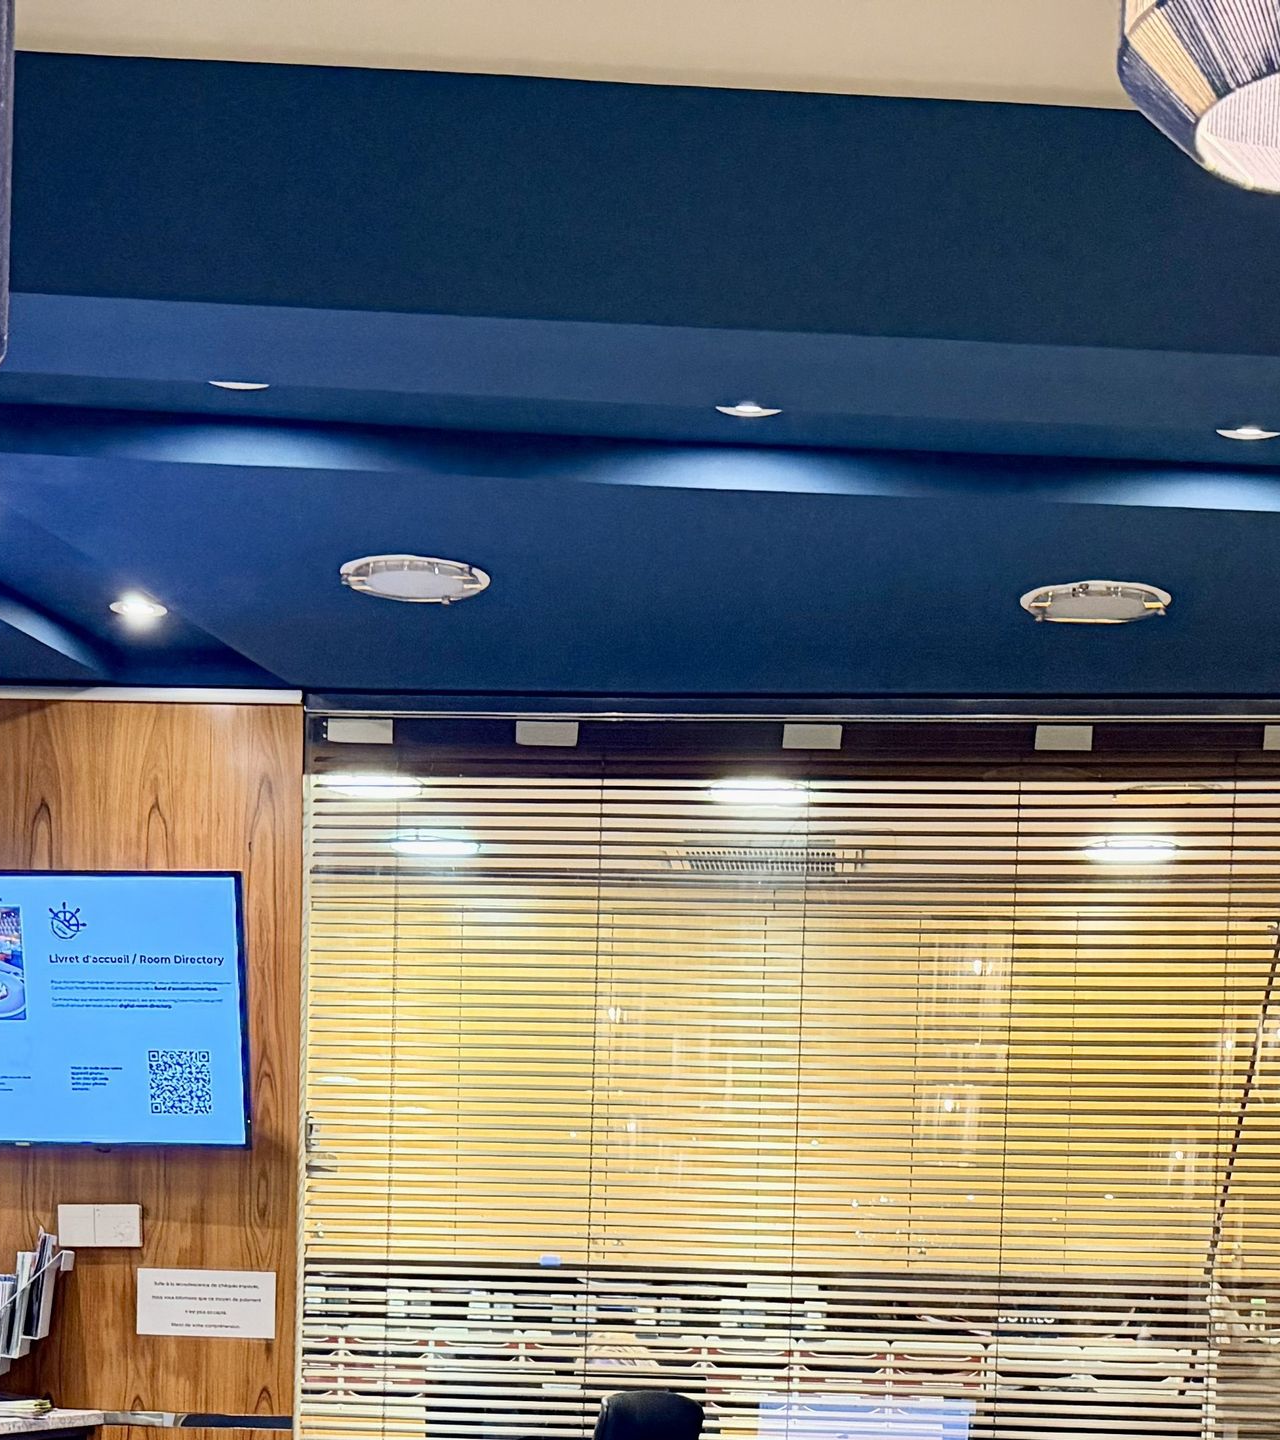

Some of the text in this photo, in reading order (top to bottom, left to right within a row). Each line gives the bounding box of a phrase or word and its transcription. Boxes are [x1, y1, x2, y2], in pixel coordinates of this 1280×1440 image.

[49, 952, 225, 967] Livret d'accueil / Room Directory
